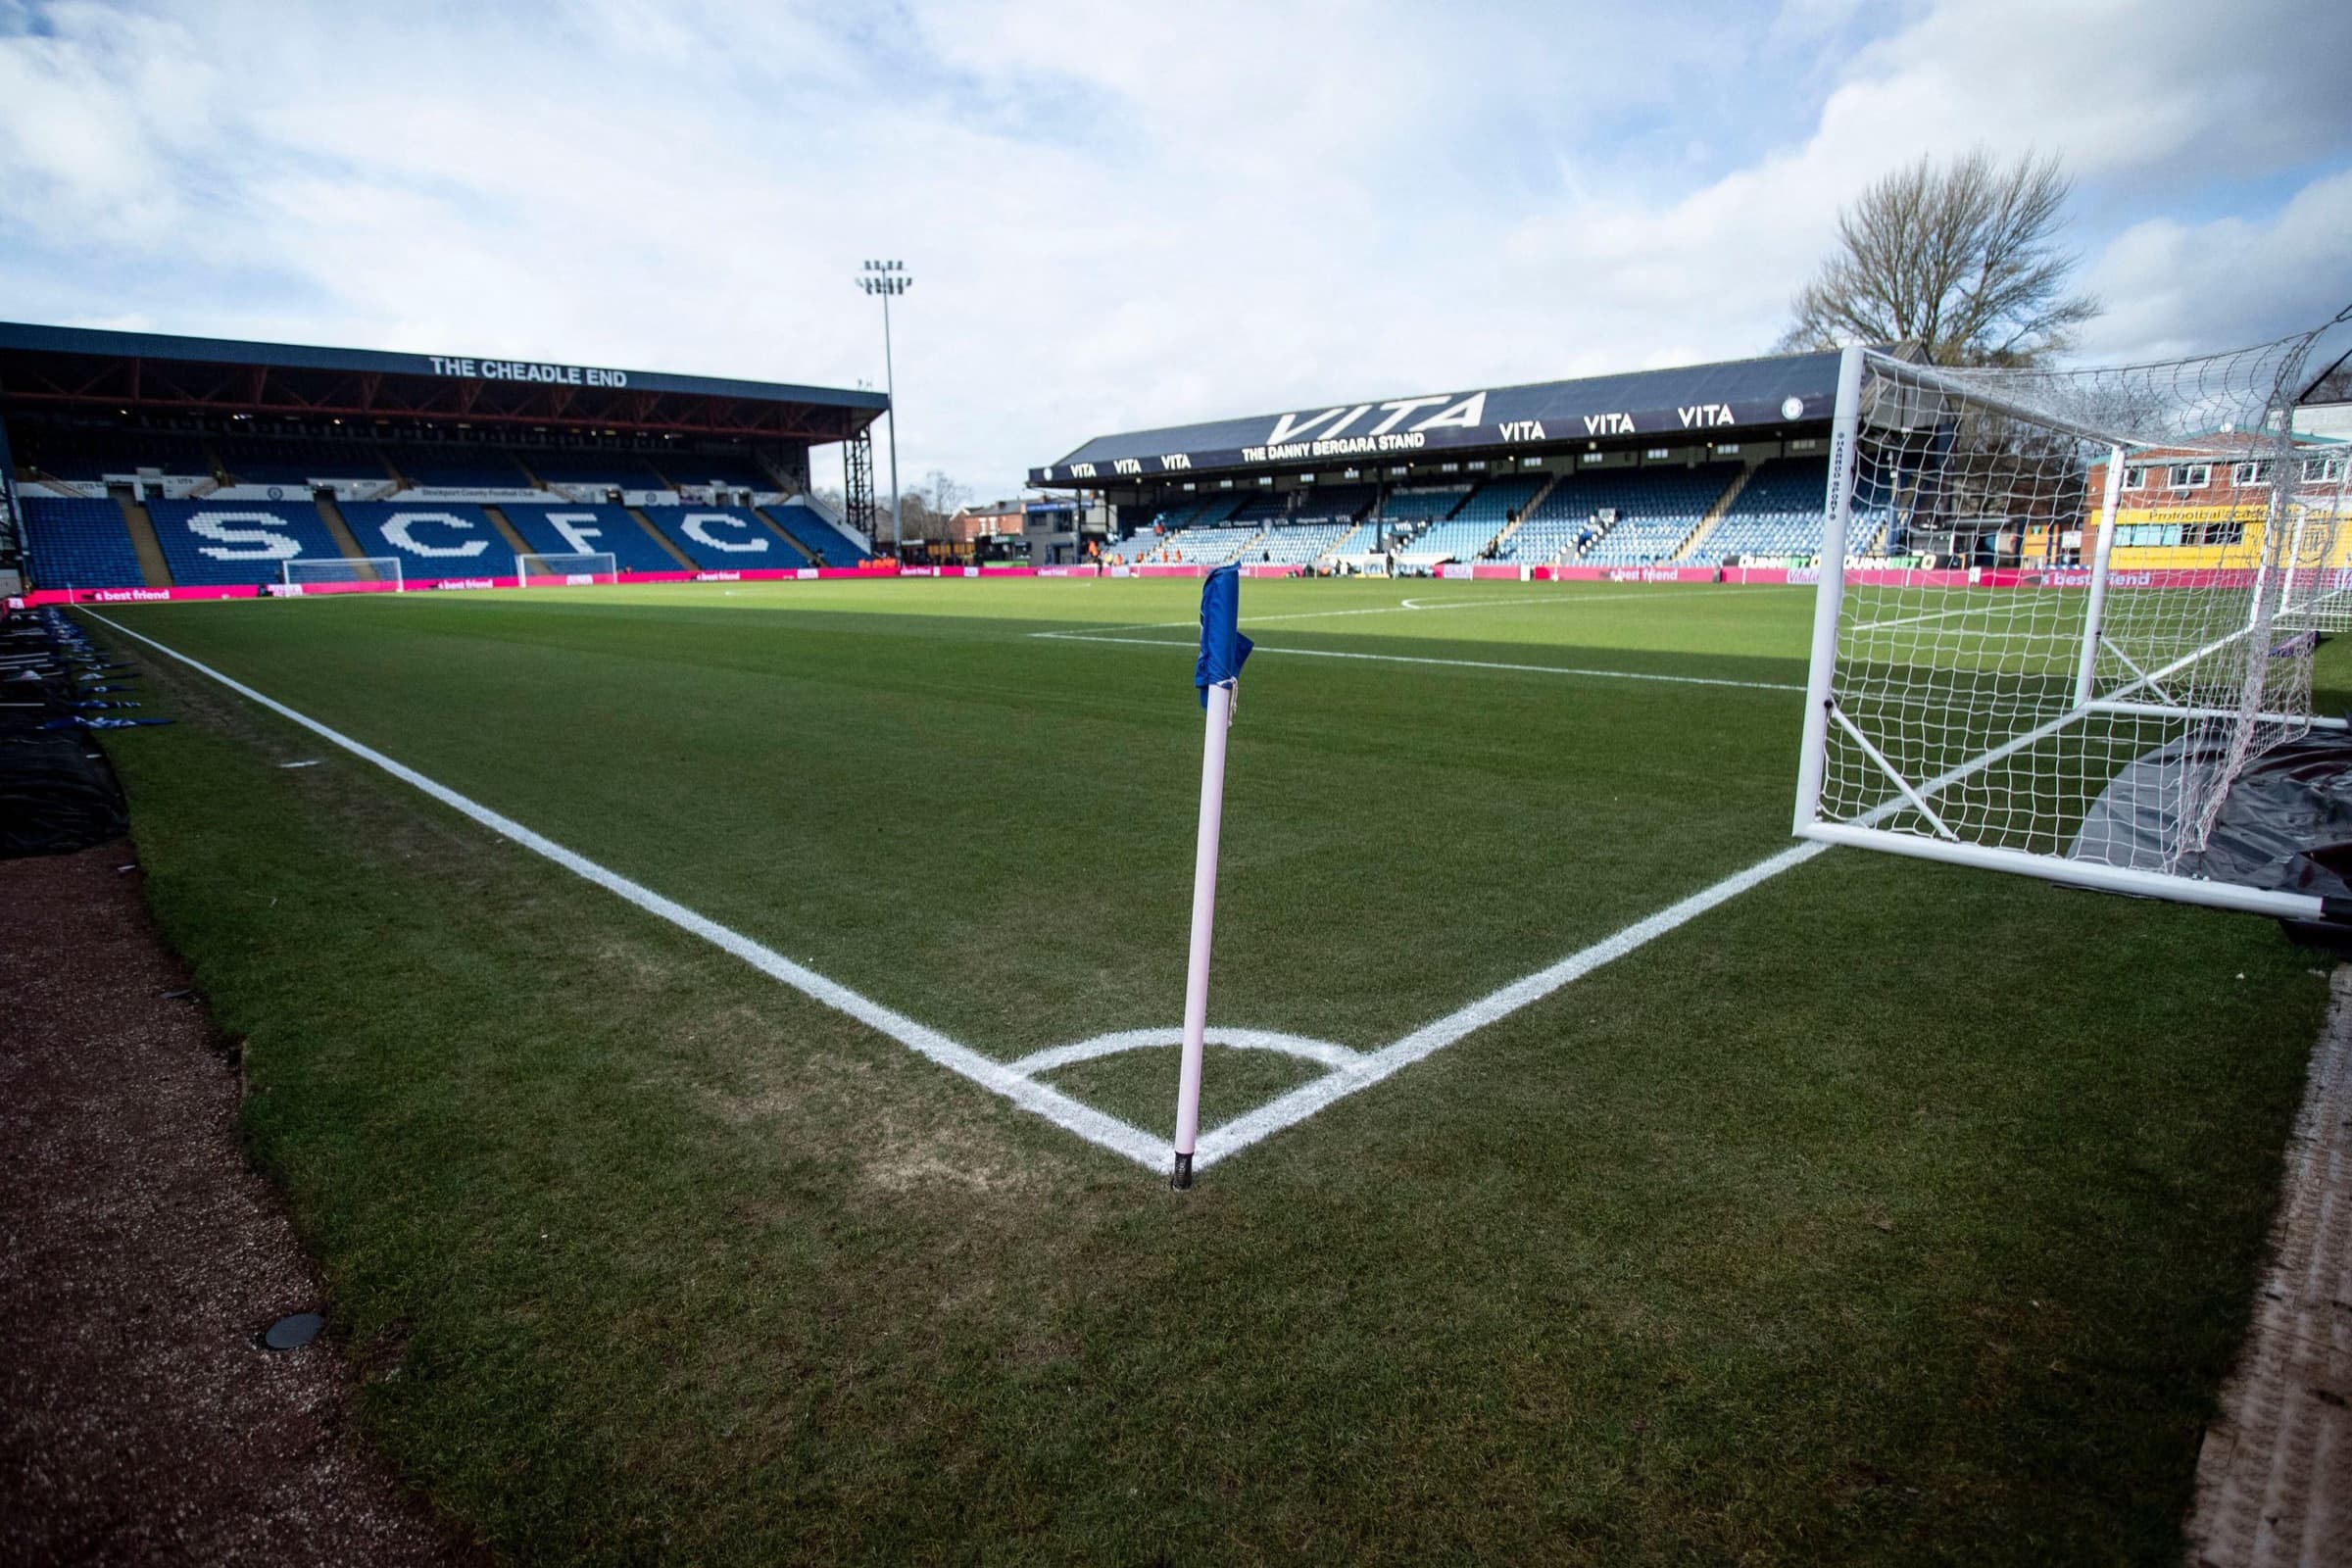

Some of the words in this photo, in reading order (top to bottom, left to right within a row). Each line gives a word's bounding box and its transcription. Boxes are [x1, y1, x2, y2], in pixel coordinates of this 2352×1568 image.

[429, 357, 476, 376] THE
[481, 361, 581, 384] CHEADLE
[586, 369, 627, 387] END
[1266, 392, 1487, 445] VITA
[1584, 413, 1635, 436] VITA
[1677, 404, 1735, 428] VITA
[1498, 420, 1545, 441] VITA
[1242, 447, 1266, 462] THE
[1268, 443, 1311, 461] DANNY
[1312, 438, 1377, 456] BERGARA
[1379, 432, 1425, 450] STAND
[1070, 463, 1097, 478] VITA
[1113, 459, 1142, 474] VITA
[1161, 453, 1191, 469] VITA
[1834, 440, 1844, 478] HARROD
[187, 512, 302, 561] S
[379, 513, 489, 557] C
[545, 514, 603, 554] F
[680, 514, 768, 552] C
[104, 590, 129, 601] best
[132, 589, 170, 600] friend
